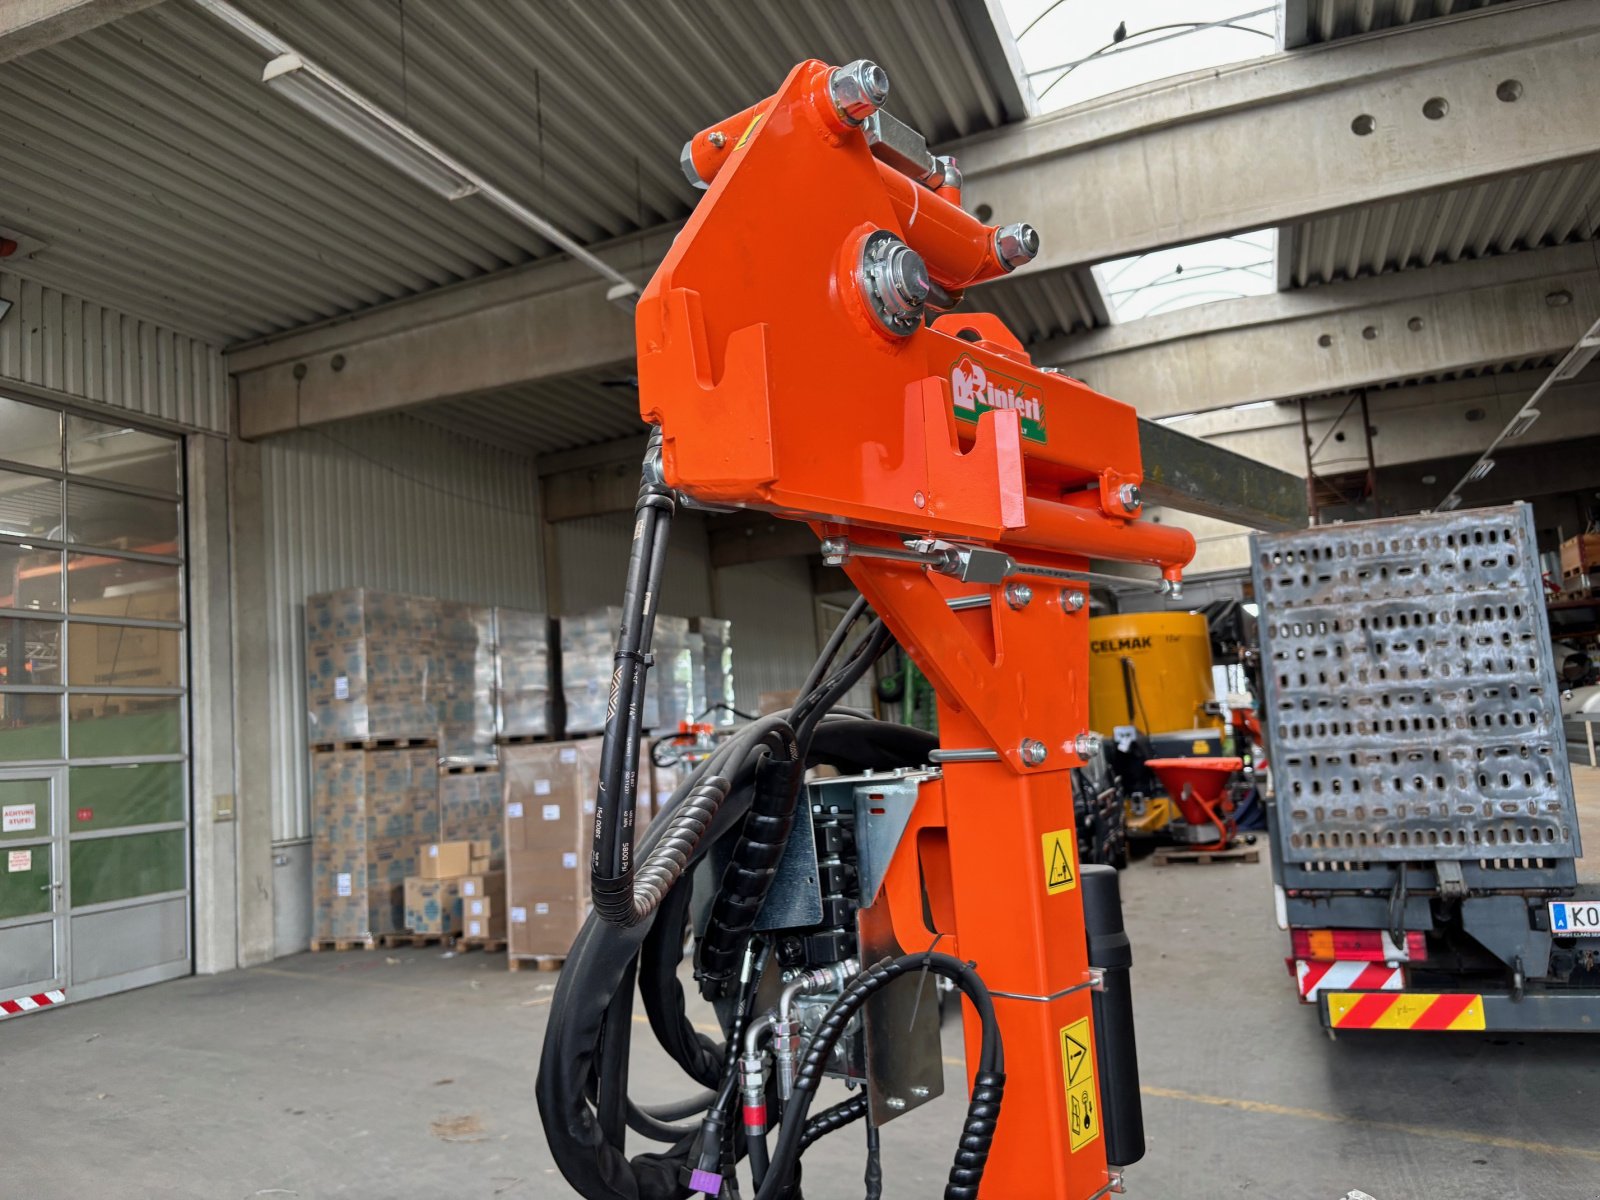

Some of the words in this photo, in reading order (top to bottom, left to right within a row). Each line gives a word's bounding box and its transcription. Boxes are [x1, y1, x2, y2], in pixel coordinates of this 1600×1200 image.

[1090, 636, 1152, 653] CELMAK
[1557, 919, 1565, 927] A
[1571, 906, 1600, 927] KO
